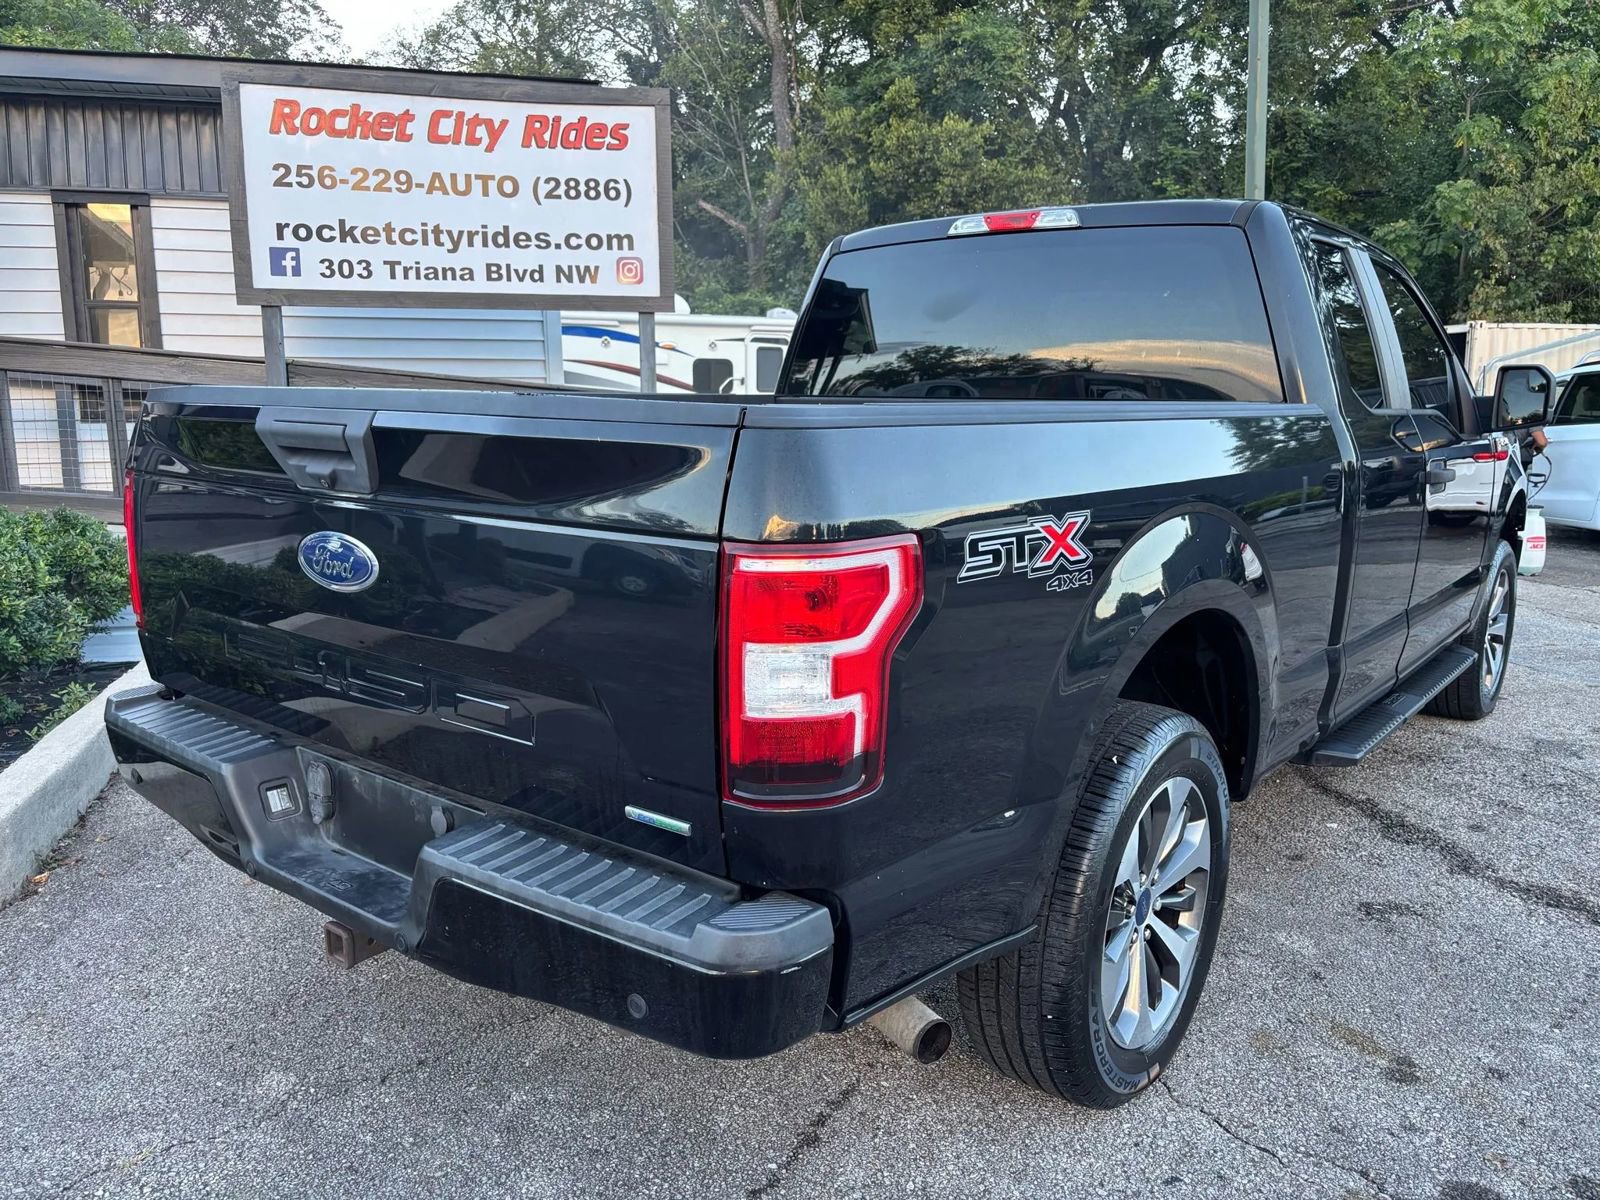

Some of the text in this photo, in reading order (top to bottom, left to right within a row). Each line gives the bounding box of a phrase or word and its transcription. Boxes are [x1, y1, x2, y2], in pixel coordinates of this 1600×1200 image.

[269, 98, 416, 142] Rocket
[521, 113, 630, 151] Rides
[272, 163, 632, 207] 256-229-AUTO (2886)
[276, 219, 634, 253] rocketcityrides.com
[319, 258, 600, 285] 303 Triana Blvd NW
[313, 540, 355, 579] Ford
[957, 510, 1093, 584] STX
